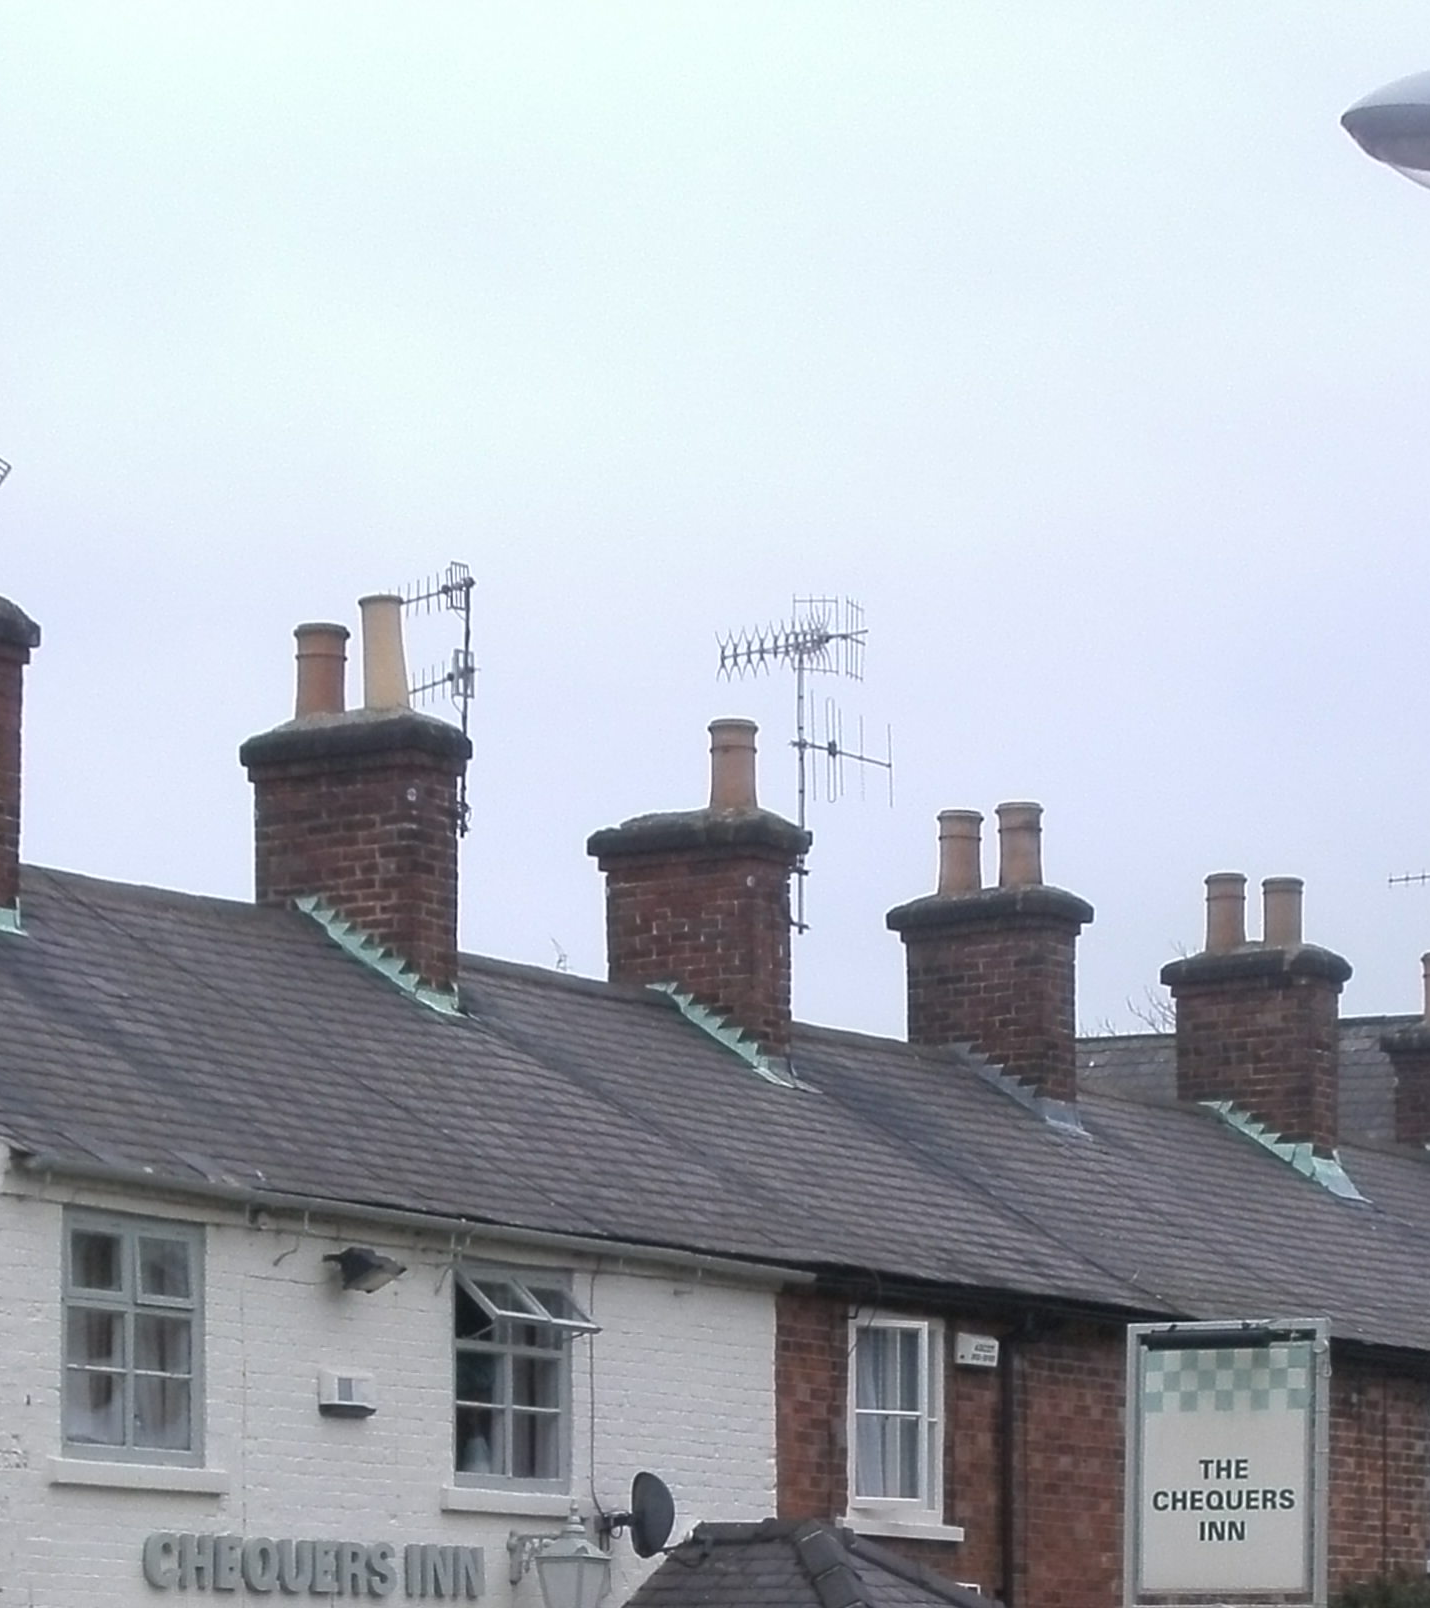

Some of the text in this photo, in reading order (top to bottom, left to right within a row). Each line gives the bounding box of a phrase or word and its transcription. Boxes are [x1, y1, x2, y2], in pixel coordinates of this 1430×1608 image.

[1199, 1459, 1248, 1480] THE
[1153, 1489, 1295, 1511] CHEQUERS
[1199, 1521, 1246, 1541] INN
[143, 1532, 485, 1599] CHEQUERS INN
